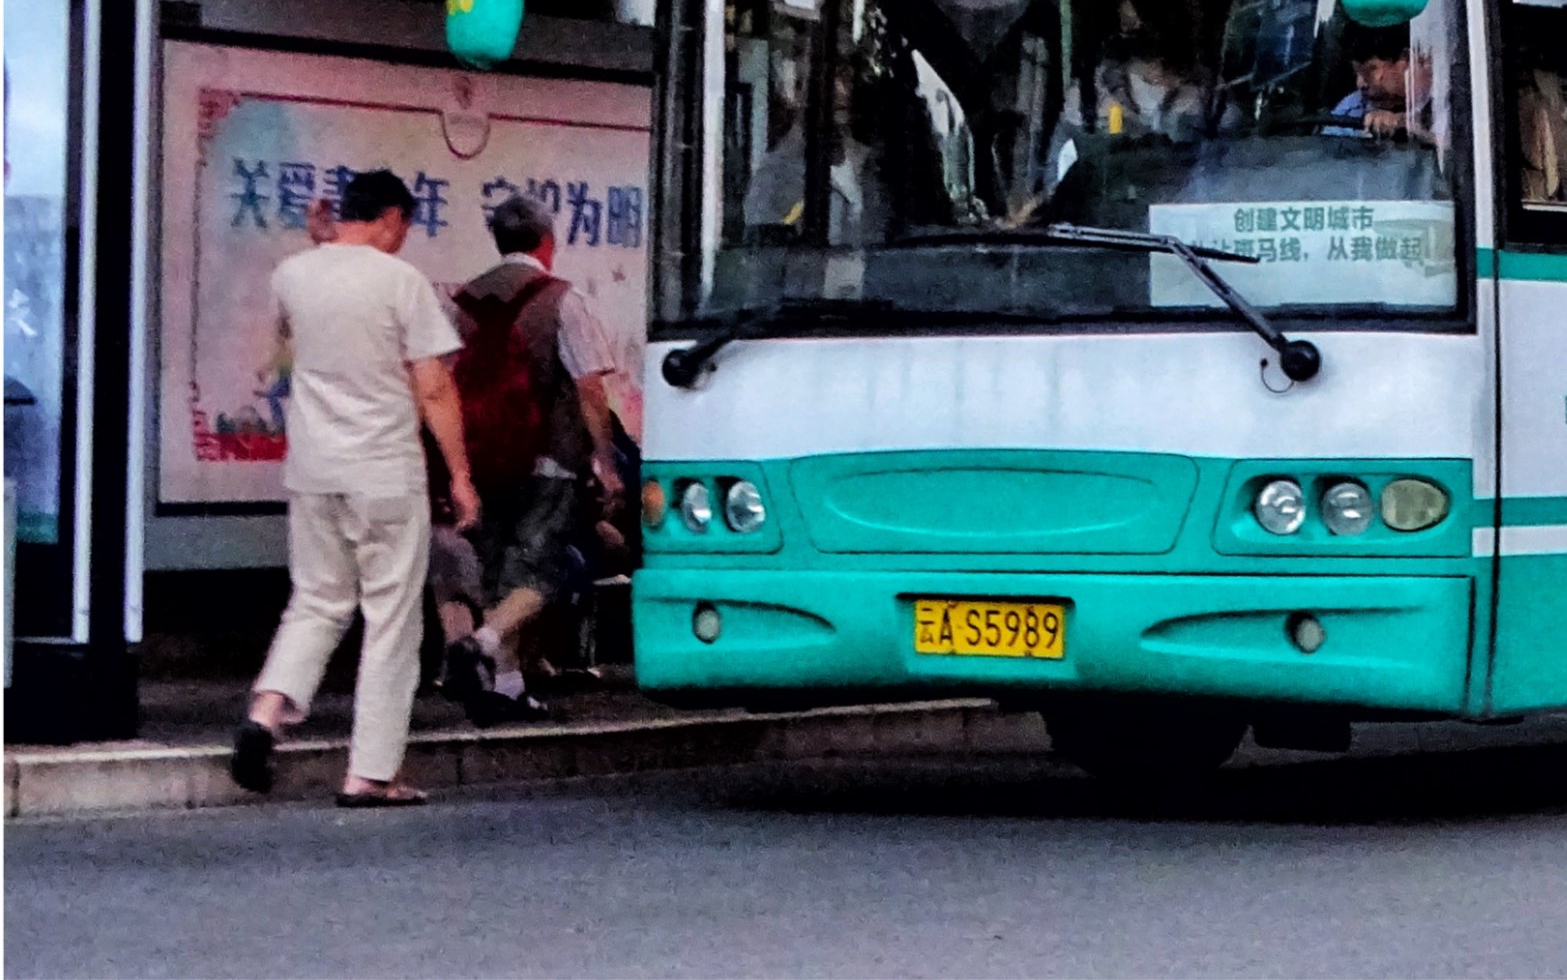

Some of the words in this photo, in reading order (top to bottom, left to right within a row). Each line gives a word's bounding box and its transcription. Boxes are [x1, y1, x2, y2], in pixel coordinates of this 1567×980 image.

[1233, 206, 1375, 234] 创建文明城市
[1192, 234, 1422, 264] 斑马线，从我做起
